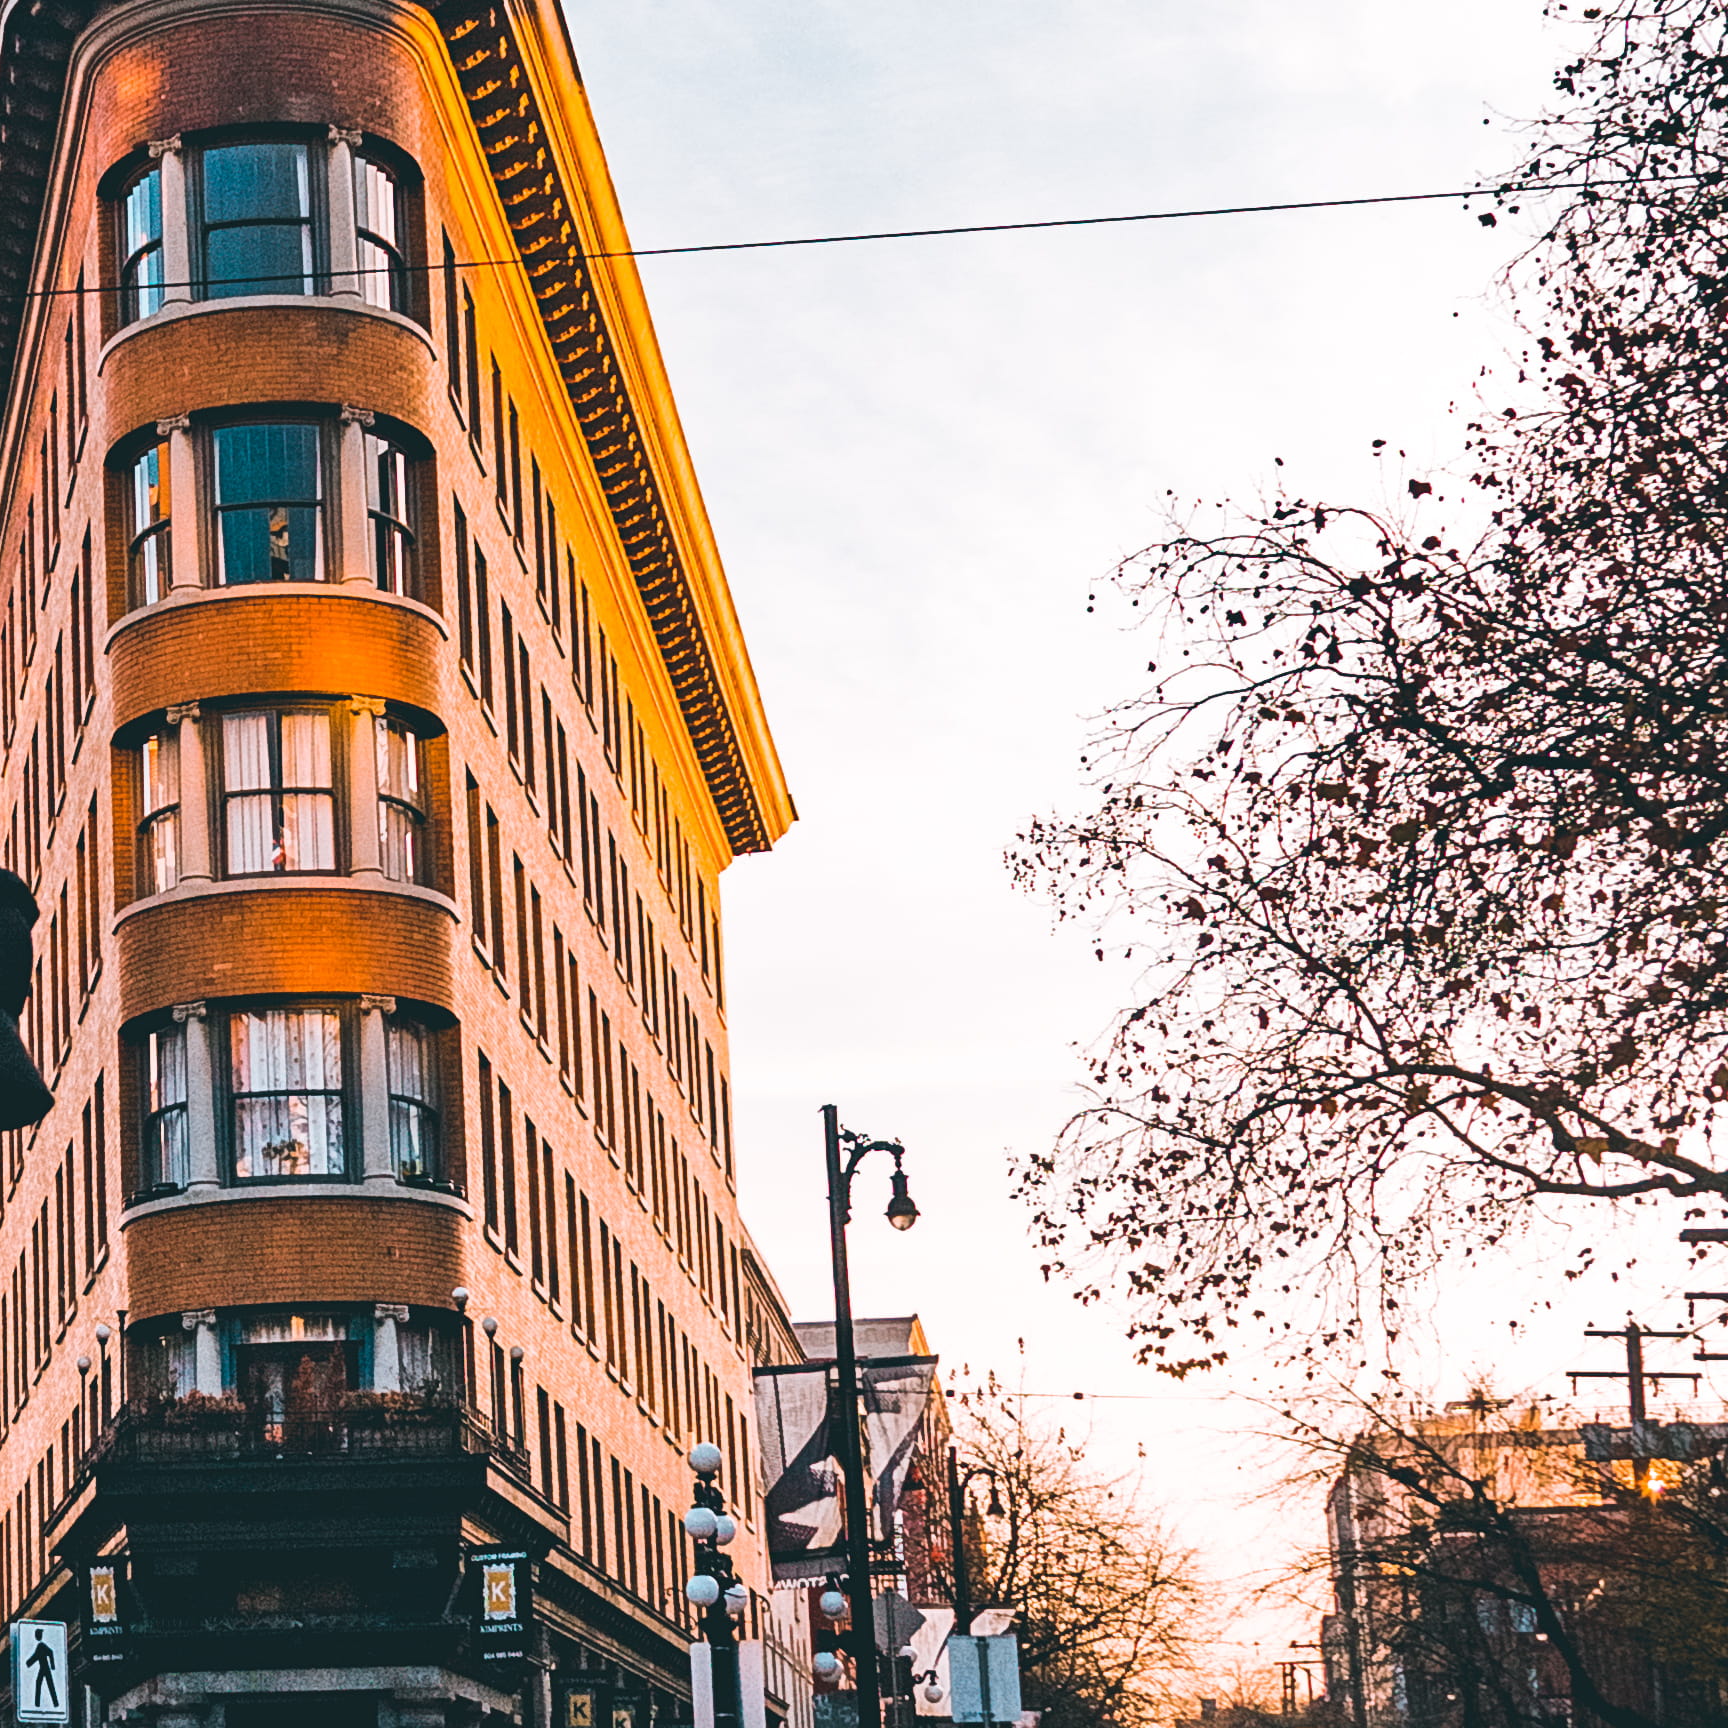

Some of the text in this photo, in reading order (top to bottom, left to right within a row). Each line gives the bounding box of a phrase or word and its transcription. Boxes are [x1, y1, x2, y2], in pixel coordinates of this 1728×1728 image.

[97, 1583, 109, 1604] K
[491, 1581, 507, 1602] K
[480, 1623, 524, 1632] KIMPRINTS
[573, 1702, 588, 1719] K
